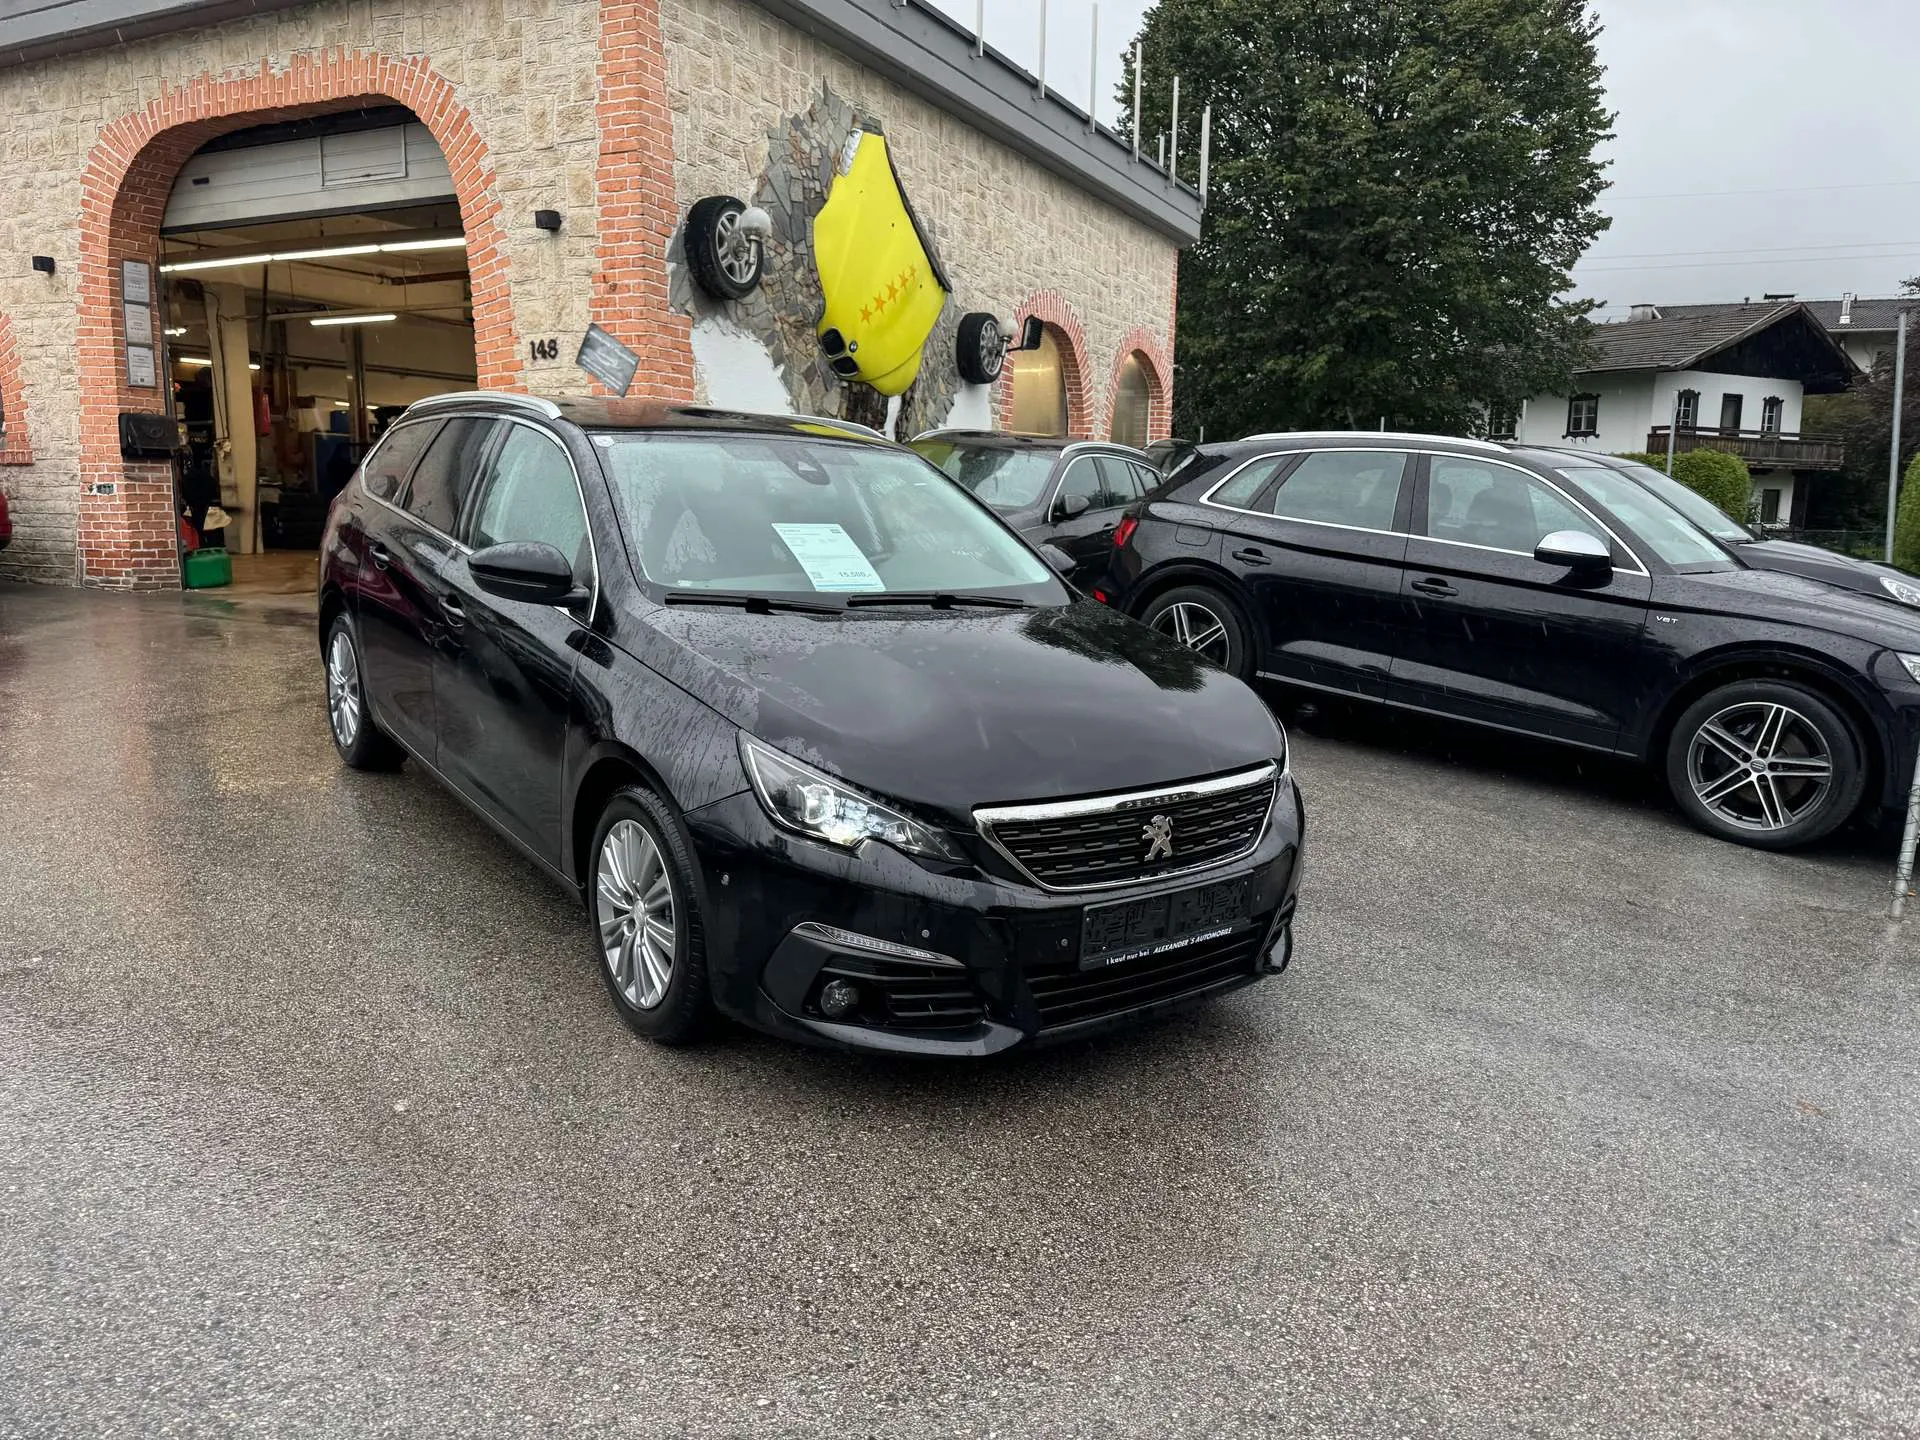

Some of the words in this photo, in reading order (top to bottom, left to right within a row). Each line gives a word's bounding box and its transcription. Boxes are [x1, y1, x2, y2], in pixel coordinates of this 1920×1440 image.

[530, 339, 559, 360] 148
[1126, 793, 1187, 808] PEUGEOT
[1110, 954, 1126, 965] kauf
[1127, 952, 1138, 960] nur
[1139, 948, 1150, 957] bei
[1153, 939, 1189, 954] ALEXANDER
[1195, 927, 1232, 943] AUTOMOBILE
